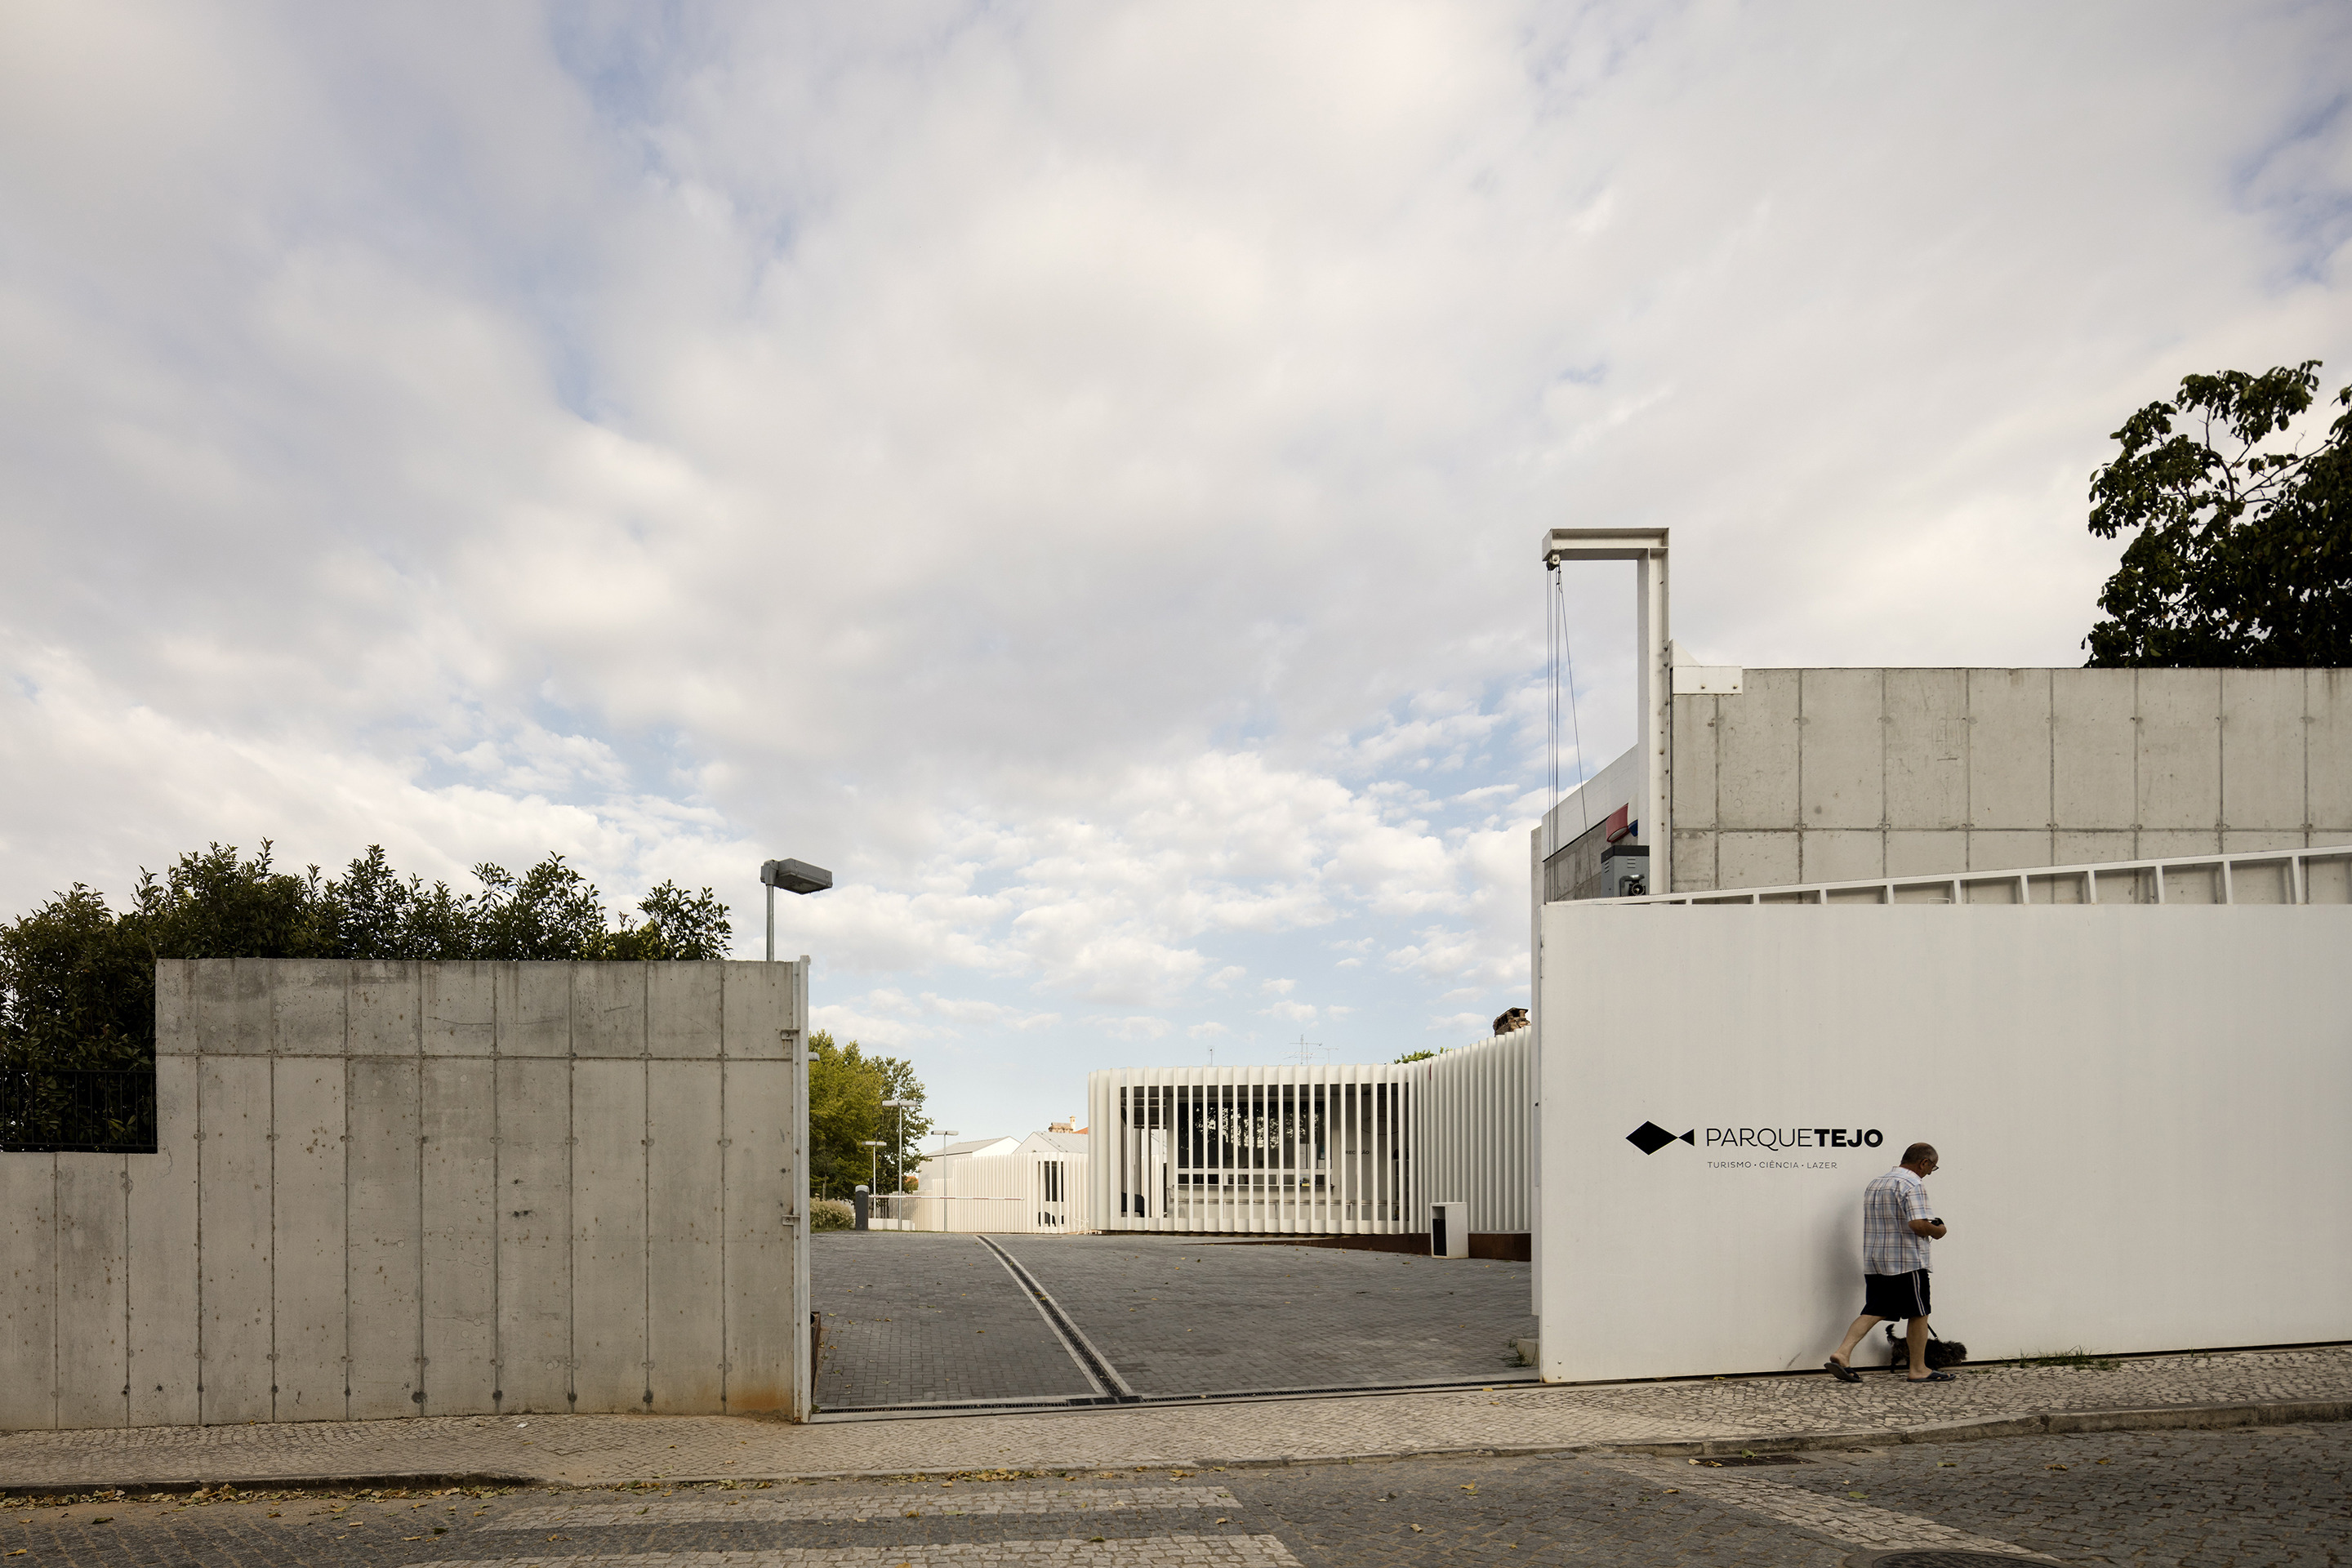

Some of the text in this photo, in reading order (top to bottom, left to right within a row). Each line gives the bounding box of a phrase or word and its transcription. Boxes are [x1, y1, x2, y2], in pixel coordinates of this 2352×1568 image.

[1707, 1159, 1838, 1169] TURISMO CIÊNCIA LAZER
